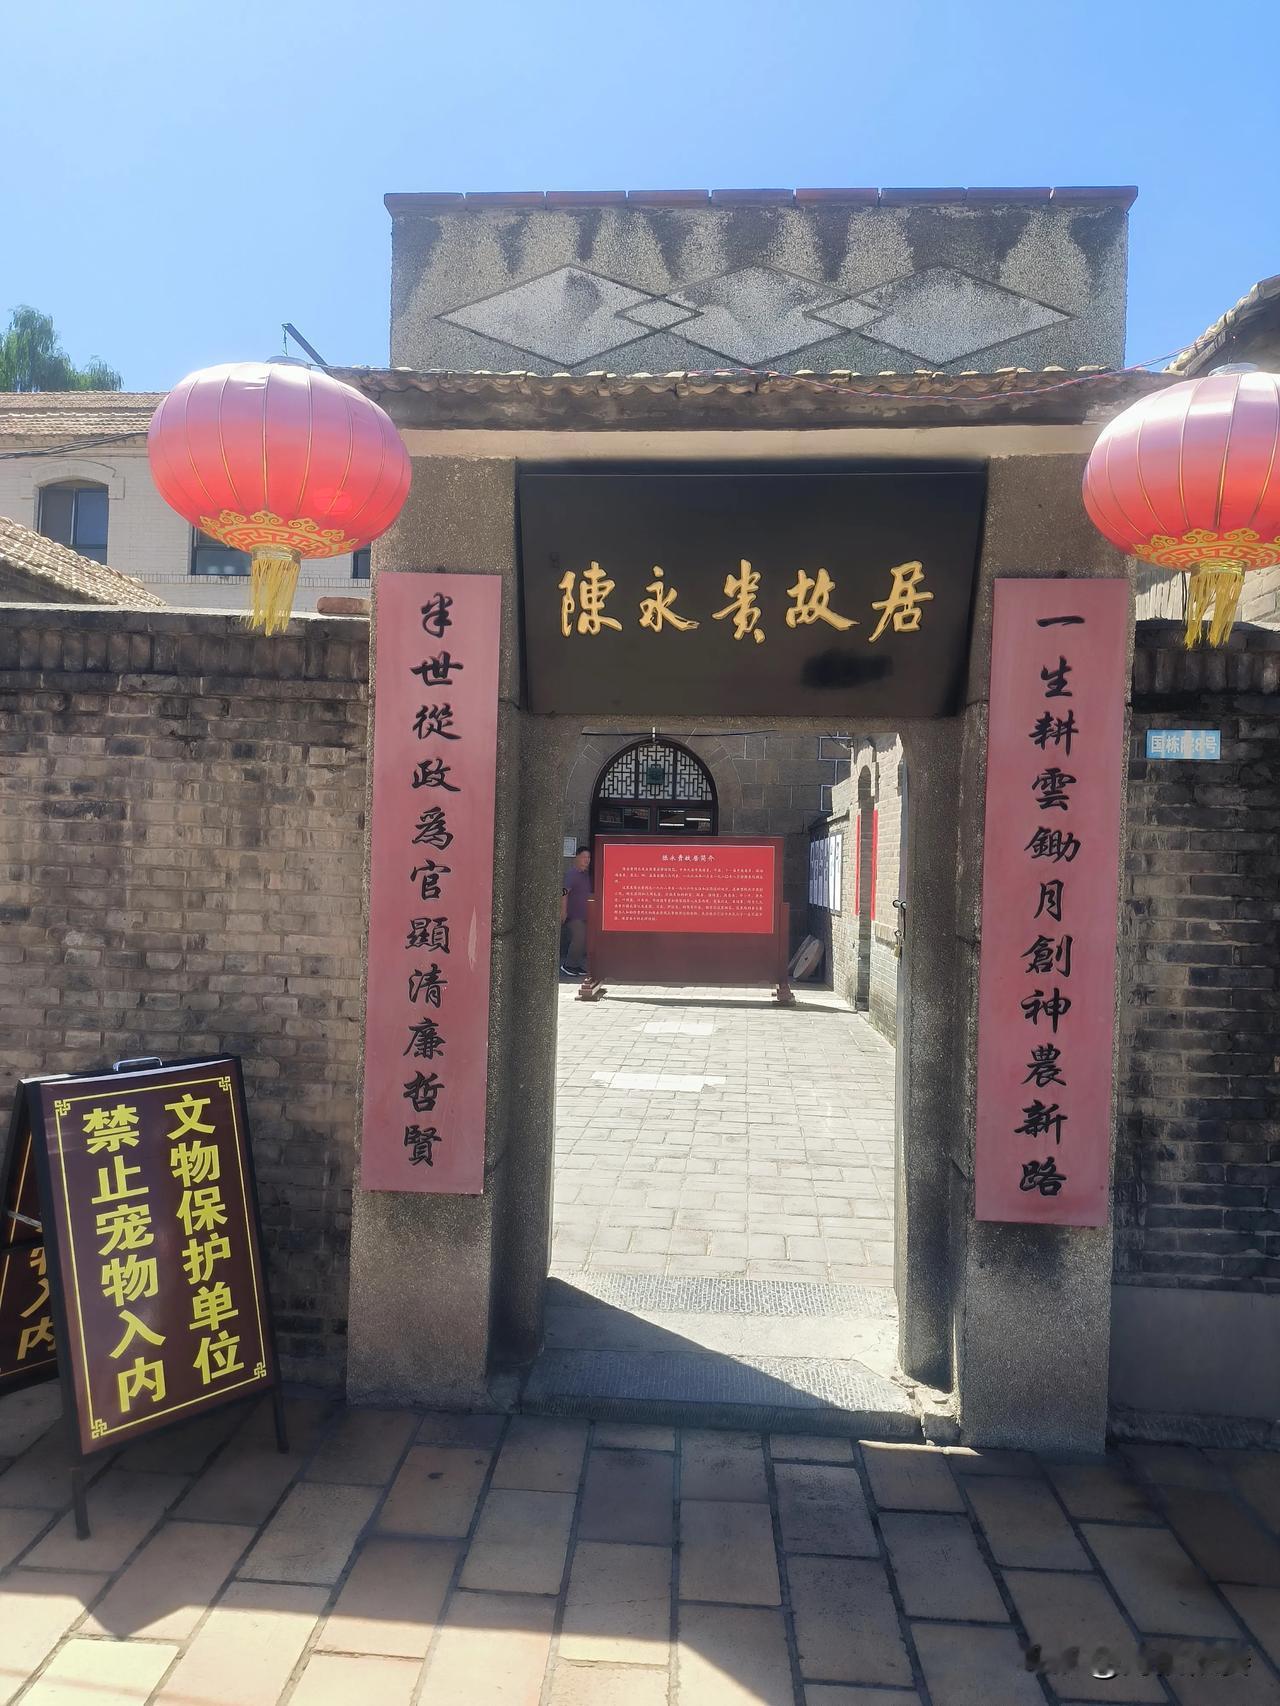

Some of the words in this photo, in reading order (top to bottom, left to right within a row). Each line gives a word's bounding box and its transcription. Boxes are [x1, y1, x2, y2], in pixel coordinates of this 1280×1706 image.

[82, 1104, 168, 1414] 禁止宠物入内
[164, 1093, 245, 1385] 文物保护单位
